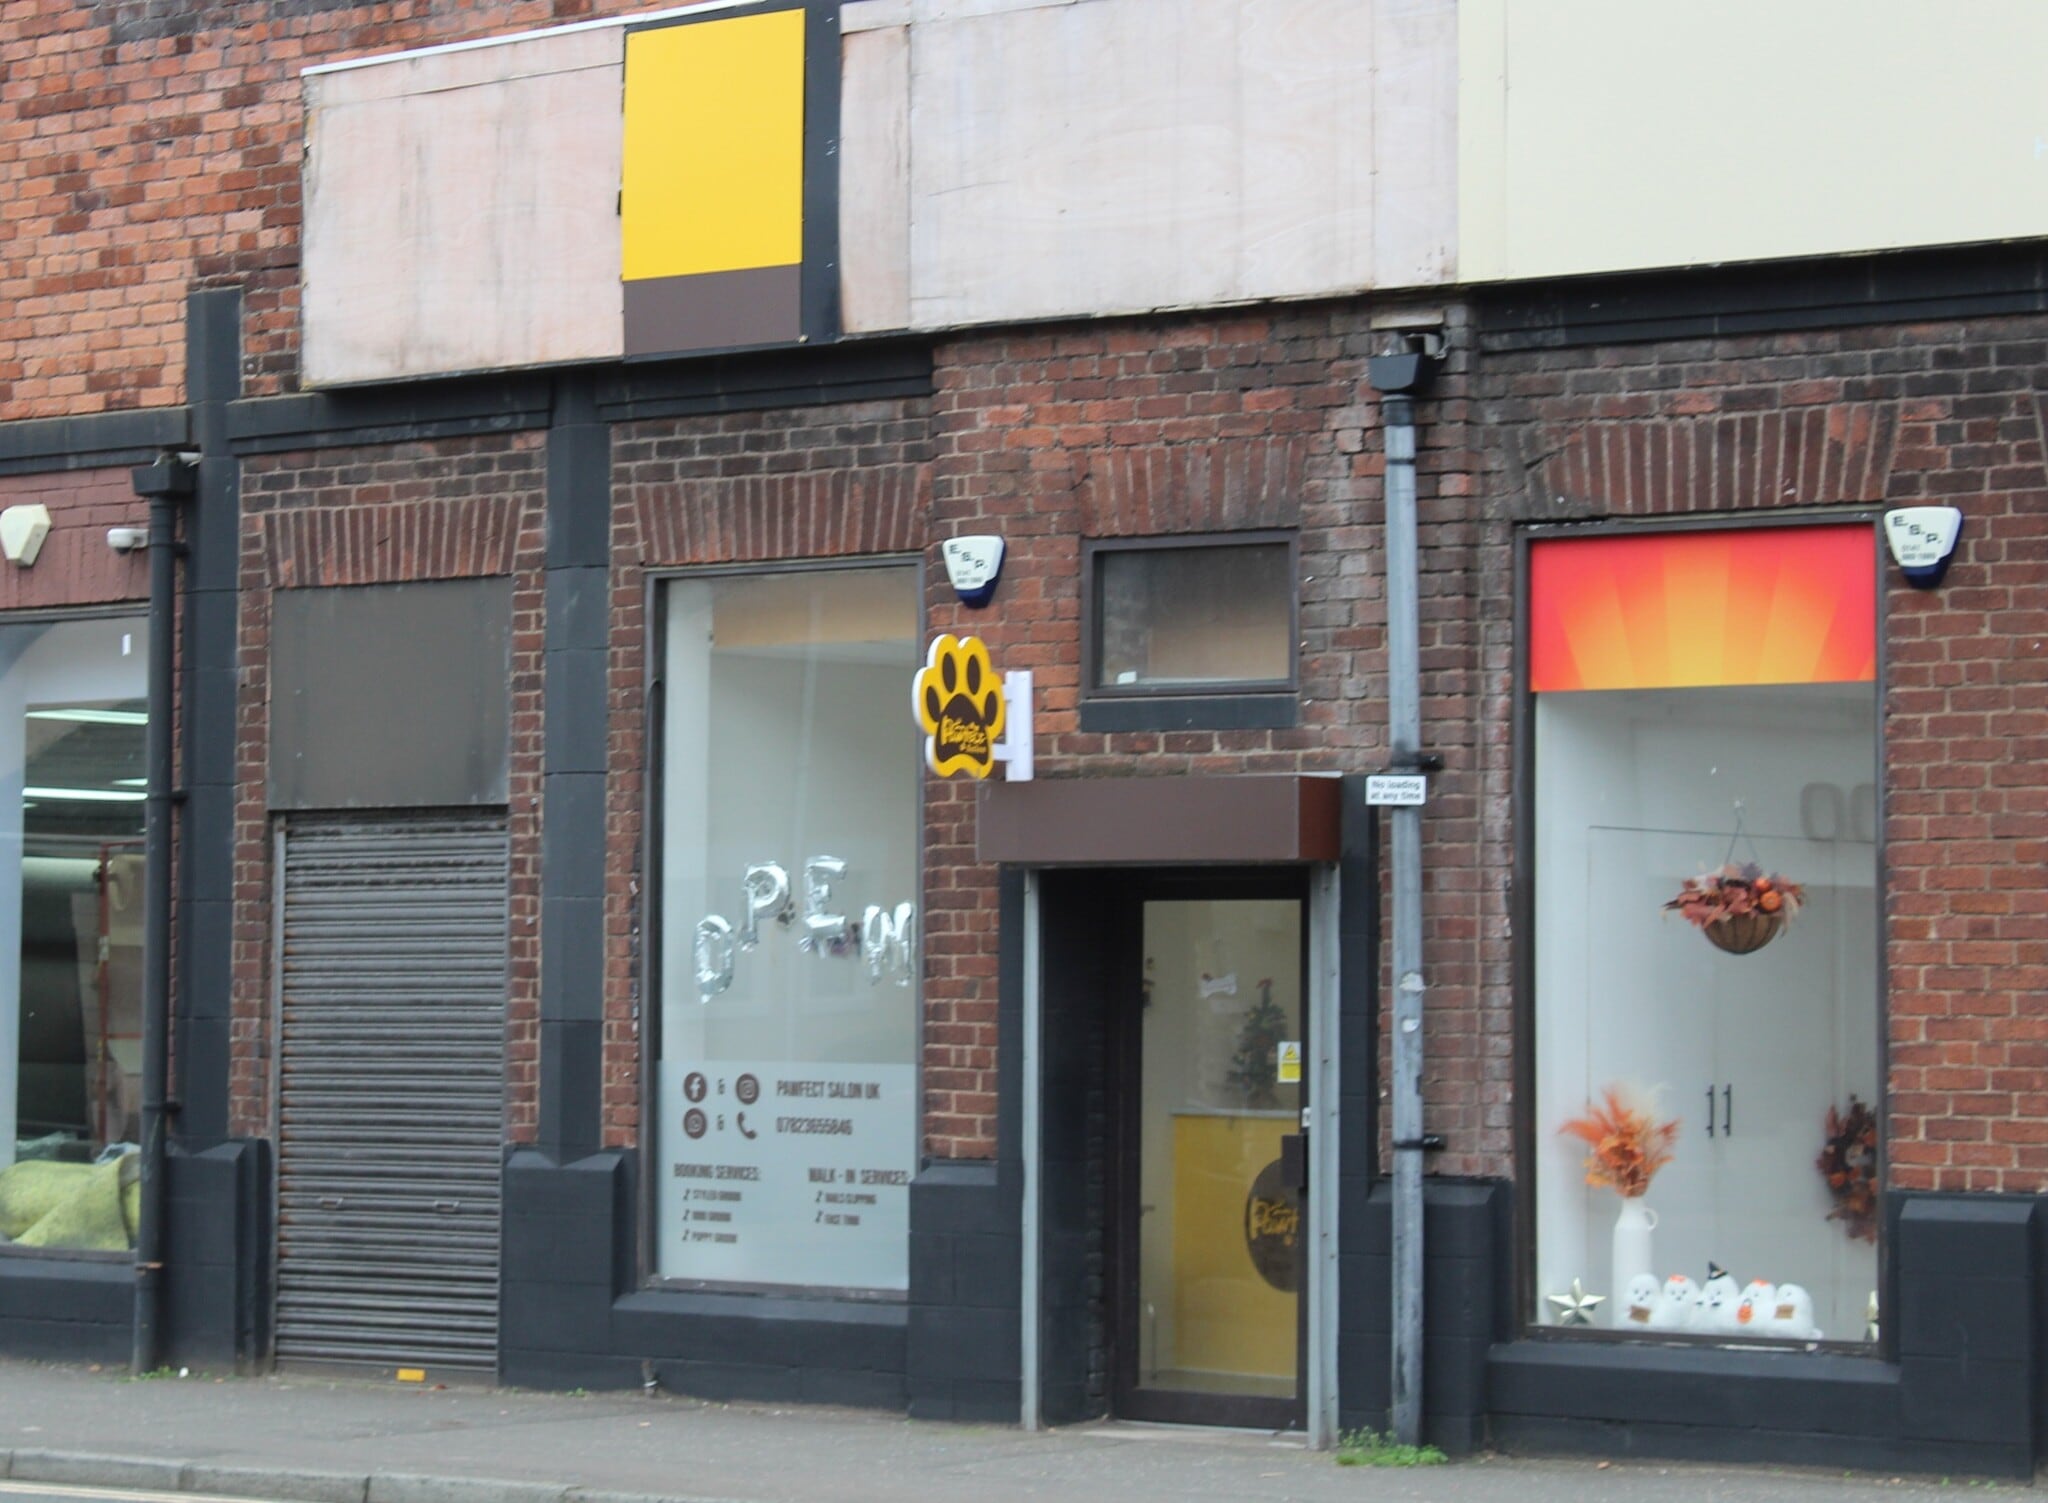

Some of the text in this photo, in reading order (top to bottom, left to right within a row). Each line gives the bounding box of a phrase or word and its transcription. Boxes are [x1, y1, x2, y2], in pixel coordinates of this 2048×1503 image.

[1371, 779, 1421, 791] No loading
[1383, 792, 1399, 802] any
[1401, 791, 1421, 800] time
[827, 1081, 863, 1099] SALON
[865, 1082, 881, 1100] UK
[674, 1163, 713, 1179] BOOKING
[808, 1167, 836, 1183] WALK
